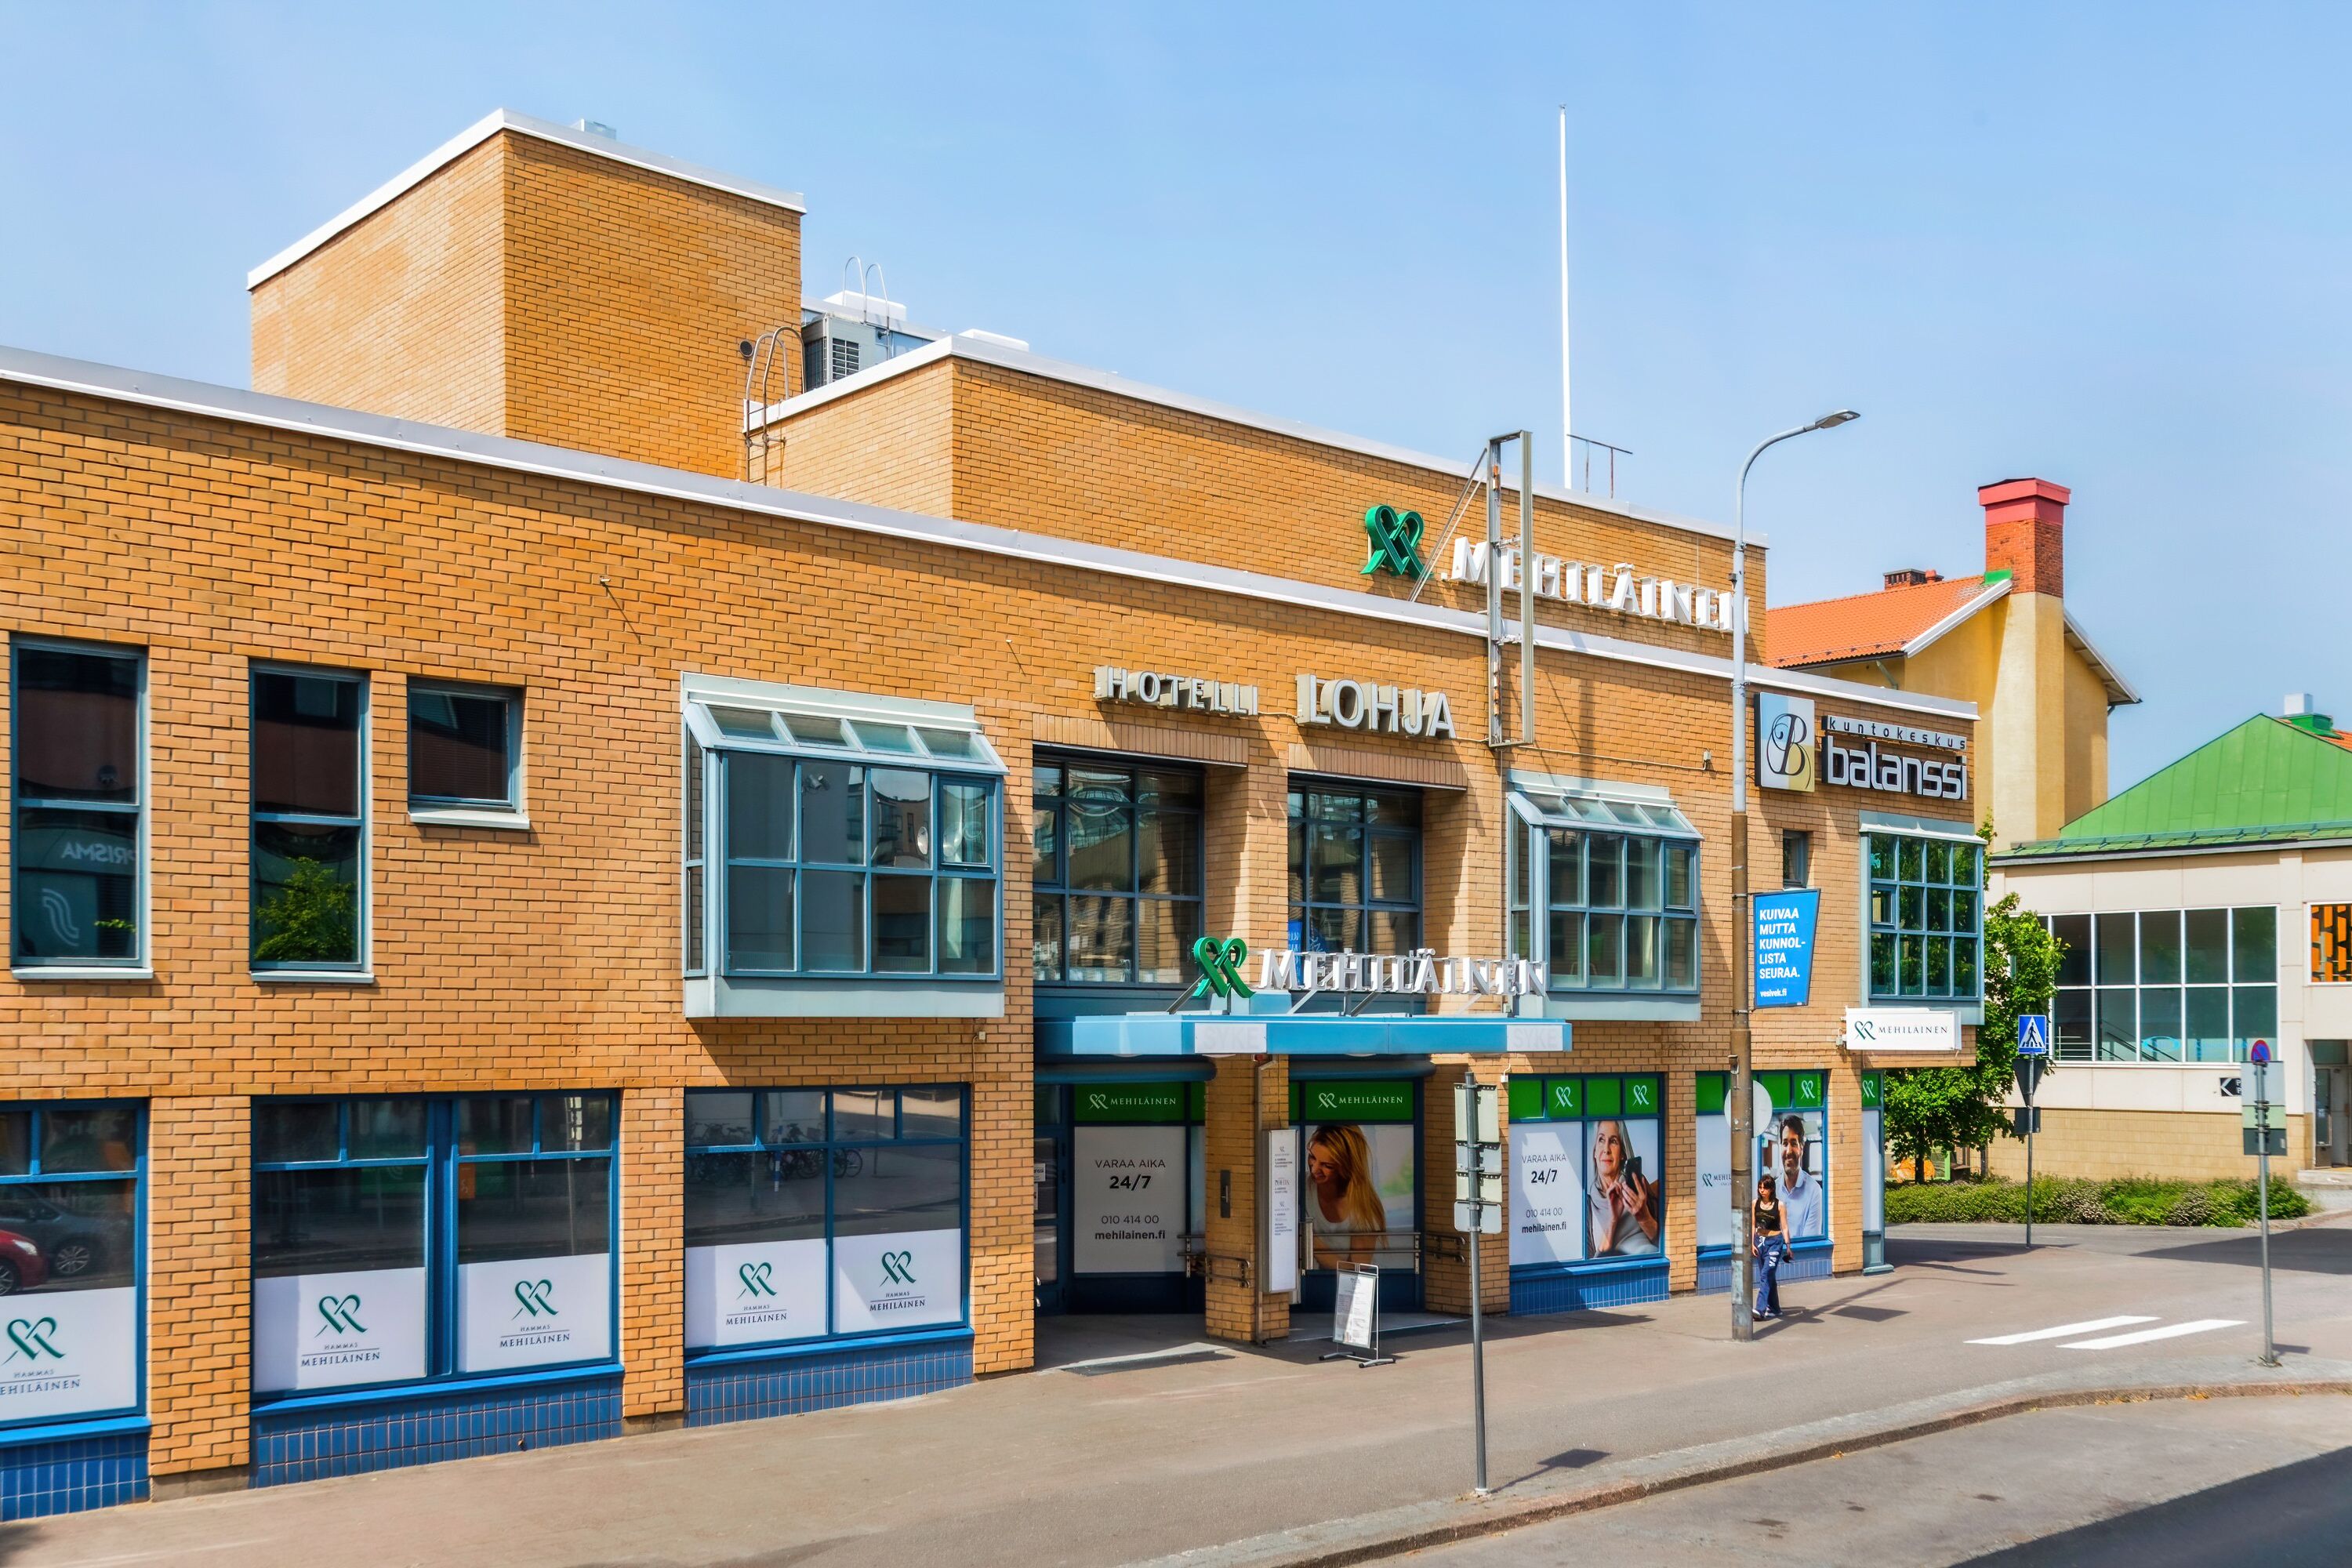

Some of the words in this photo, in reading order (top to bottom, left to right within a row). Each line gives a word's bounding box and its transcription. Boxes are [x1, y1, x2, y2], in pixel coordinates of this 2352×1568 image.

[1451, 536, 1749, 634] MEHILÄINEN
[1094, 665, 1258, 716] HOTELLI
[1296, 673, 1457, 739] LOHJA
[1829, 717, 1965, 750] kuntokeskus
[1827, 735, 1968, 800] balanssi
[1759, 908, 1799, 920] KUIVAA
[1759, 923, 1796, 935] MUTTA
[1759, 937, 1806, 949] KUNNOL-
[1759, 953, 1786, 964] LISTA
[1258, 948, 1547, 997] MEHILÄINEN
[1759, 967, 1800, 979] SEURAA.
[1110, 1095, 1176, 1105] MEHILÄINEN
[1338, 1094, 1403, 1105] MEHILÄINEN
[1095, 1160, 1135, 1168] VARAA
[1138, 1160, 1166, 1168] AIKA
[1522, 1154, 1547, 1163] VARAA
[1550, 1153, 1566, 1162] AIKA
[1109, 1174, 1152, 1191] 24/7
[1530, 1168, 1558, 1185] 24/7
[1526, 1209, 1537, 1218] 010
[1540, 1208, 1552, 1217] 414
[1553, 1207, 1563, 1216] 00
[1101, 1215, 1120, 1225] 010
[1123, 1215, 1141, 1224] 414
[1145, 1214, 1160, 1224] 00
[1522, 1221, 1566, 1233] mehilainen.fi
[1095, 1229, 1166, 1240] mehilainen.fi
[13, 1367, 55, 1378] HAMMAS
[0, 1379, 81, 1395] EHILÄINEN
